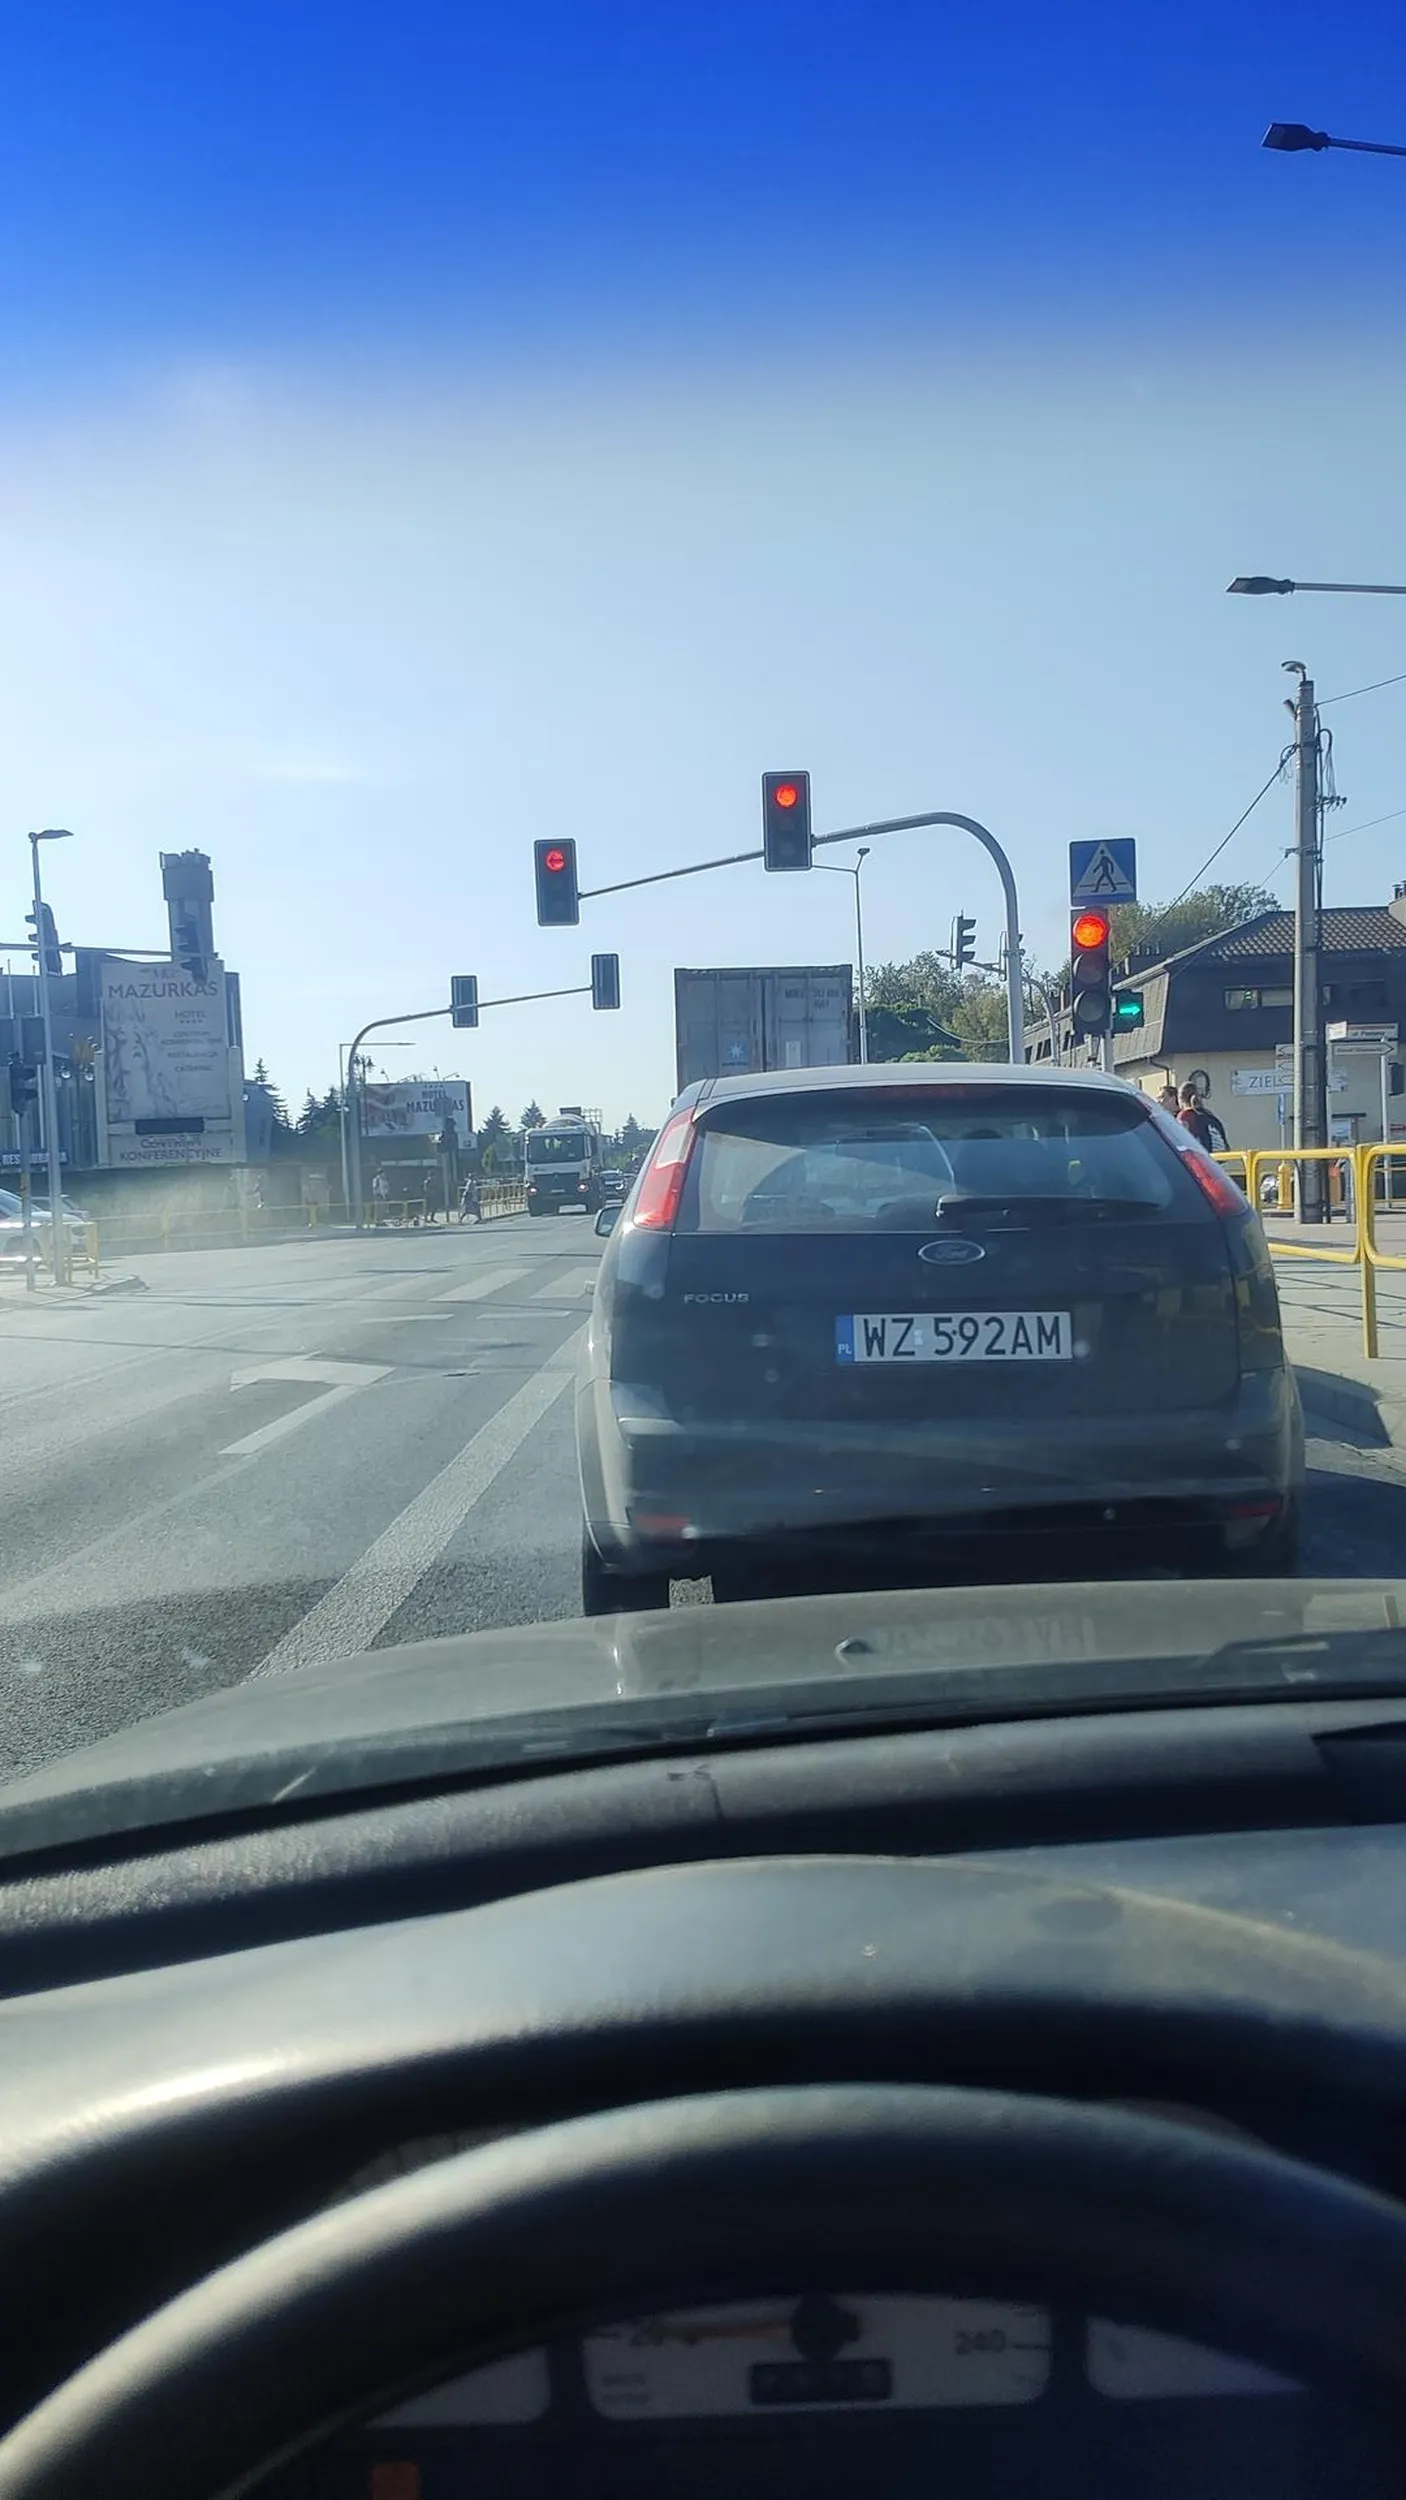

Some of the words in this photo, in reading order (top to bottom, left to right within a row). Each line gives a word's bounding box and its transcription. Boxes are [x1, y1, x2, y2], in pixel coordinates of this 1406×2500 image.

[108, 981, 218, 999] MAZURKAS
[174, 1009, 207, 1020] HOTEL
[406, 1099, 465, 1113] MAZUAS
[120, 1148, 223, 1161] KONFERENCYJNE
[683, 1292, 750, 1304] FOCUS
[863, 1317, 916, 1357] WZ
[933, 1314, 1062, 1356] 592AM
[838, 1344, 852, 1355] PL
